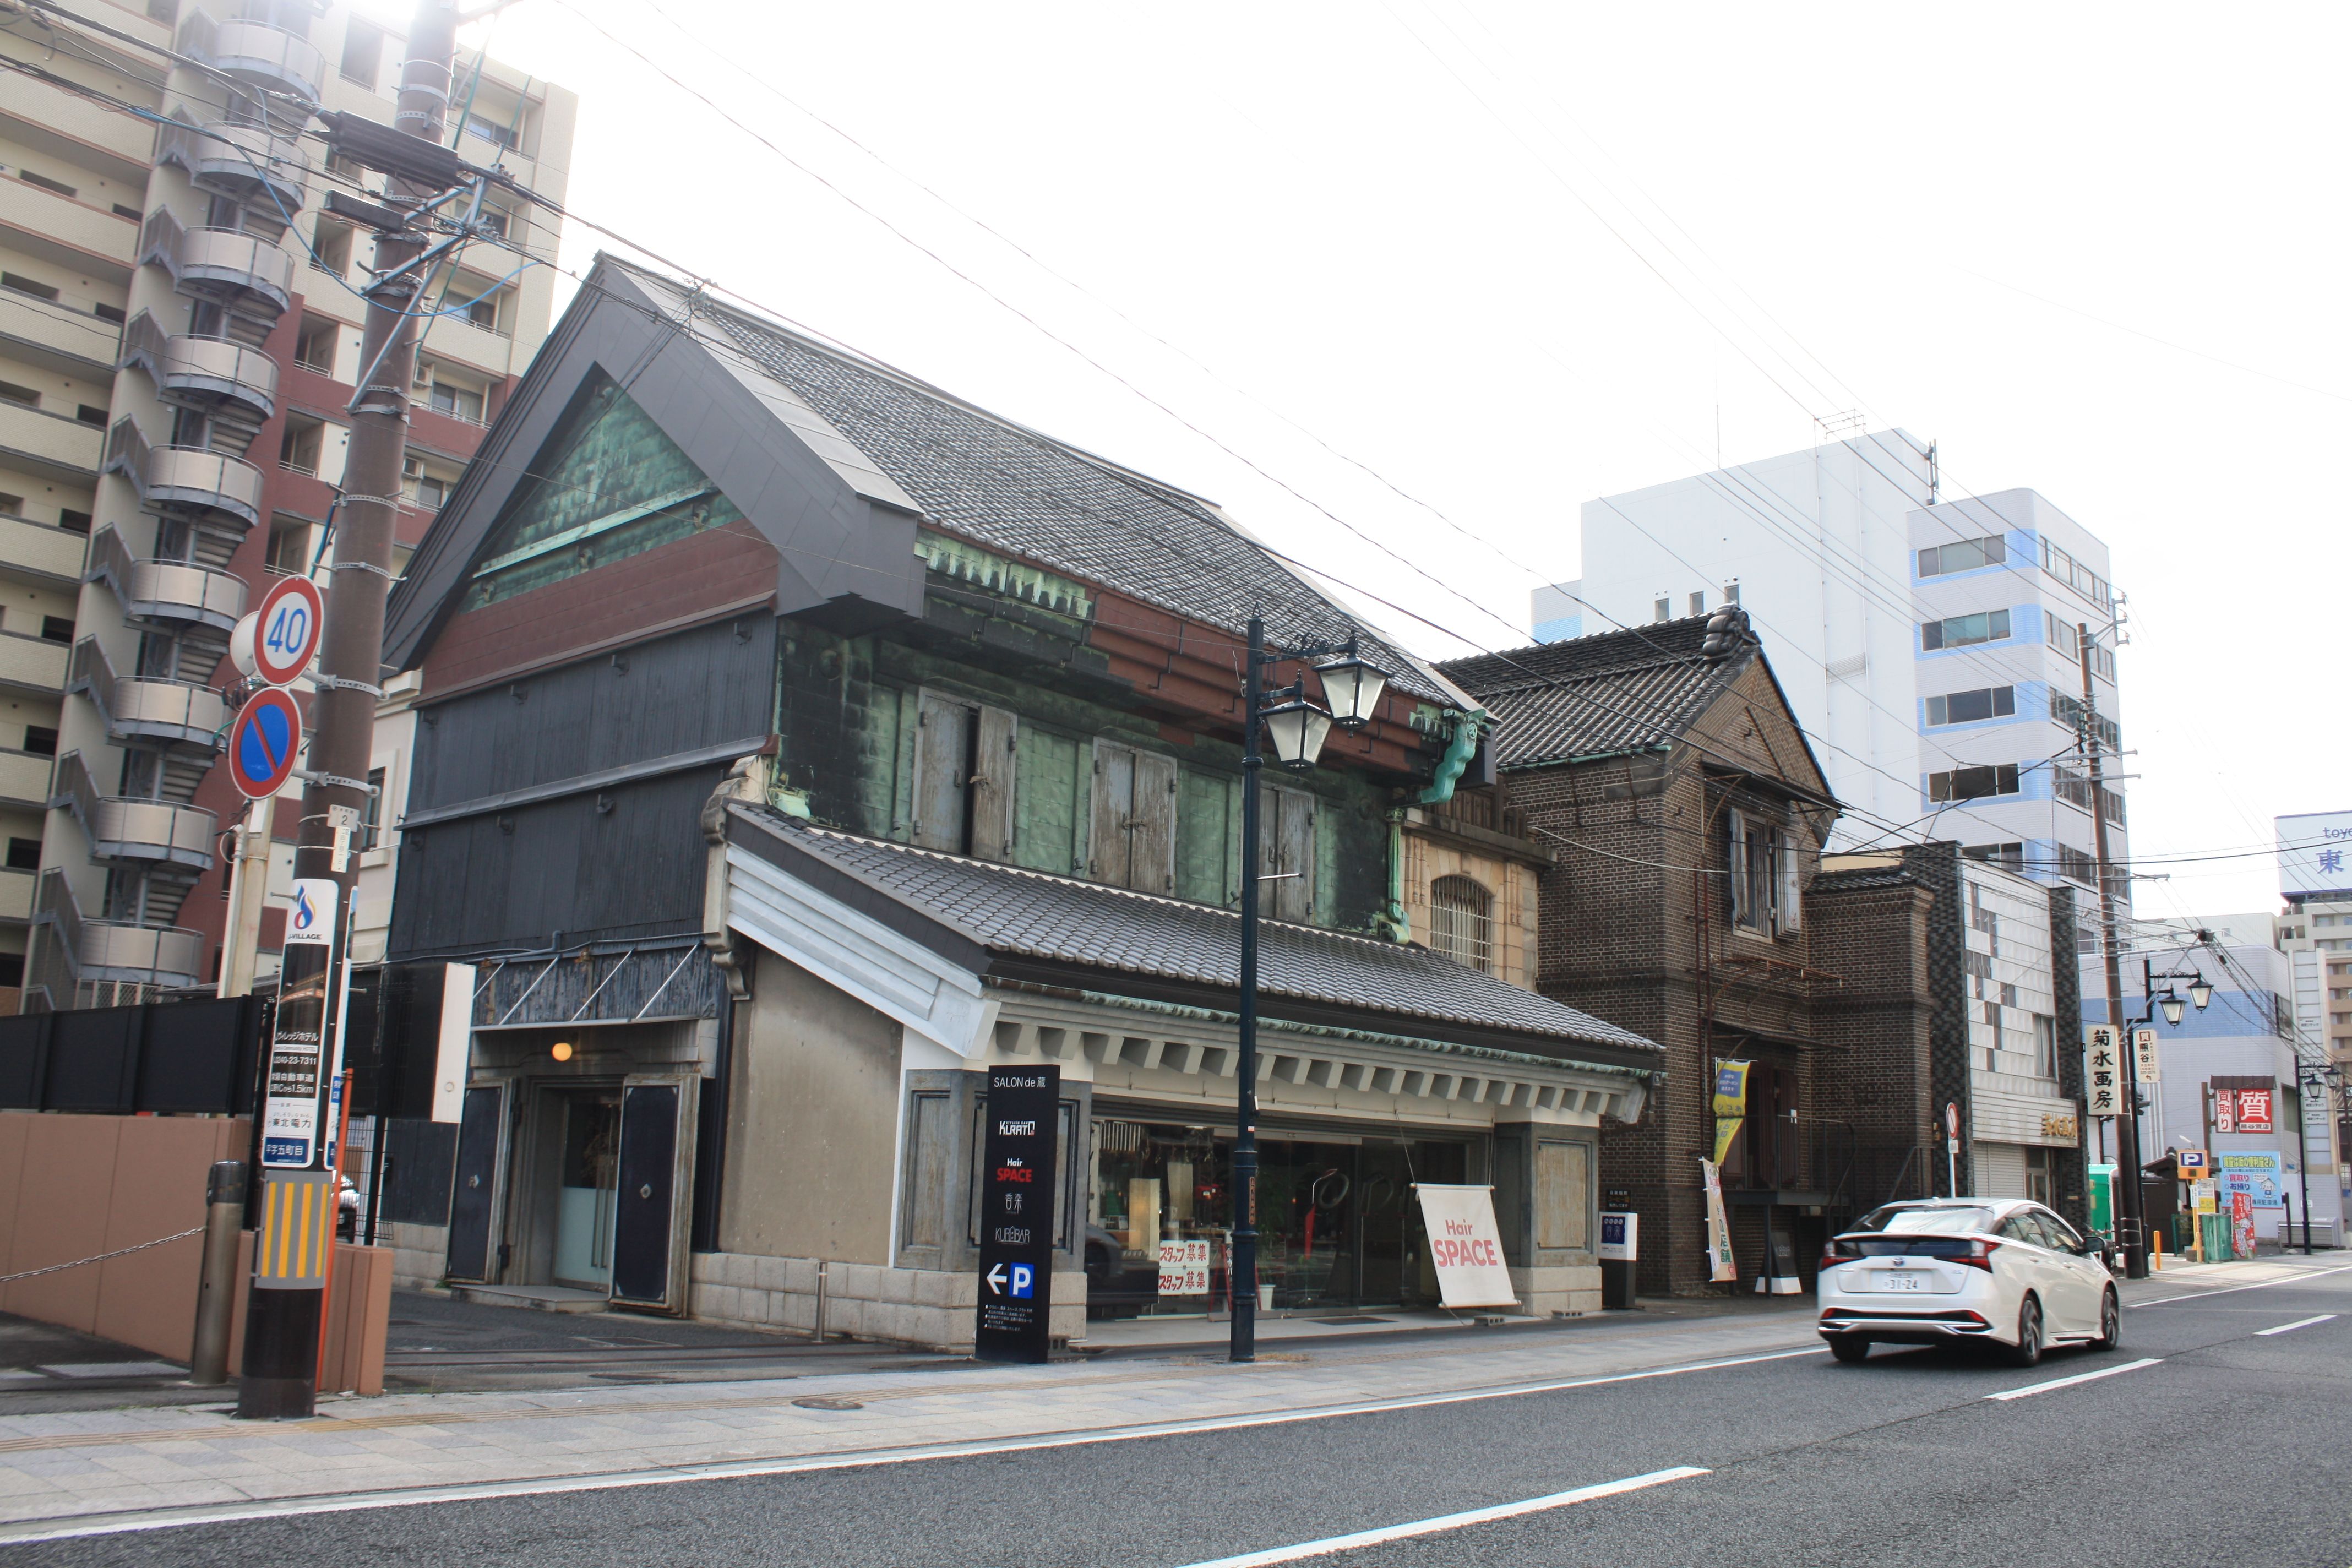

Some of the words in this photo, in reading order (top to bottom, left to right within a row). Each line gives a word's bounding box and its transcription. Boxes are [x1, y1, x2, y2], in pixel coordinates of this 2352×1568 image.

[267, 607, 306, 654] 40
[341, 815, 348, 825] 2
[2316, 849, 2344, 874] 東
[2090, 1028, 2114, 1110] 菊水画房
[994, 1077, 1023, 1087] SALON
[1025, 1077, 1035, 1087] de
[1037, 1077, 1046, 1088] 蔵
[2218, 1090, 2231, 1130] 買取り
[2239, 1091, 2269, 1121] 質
[273, 1118, 311, 1128] 東北電力
[1007, 1158, 1023, 1167] Hair
[2184, 1153, 2199, 1166] P
[997, 1168, 1032, 1182] SPACE
[1445, 1218, 1473, 1235] Hair
[1159, 1243, 1207, 1263] スタッフ募集
[1434, 1239, 1498, 1267] SPACE
[1013, 1267, 1031, 1295] P
[1158, 1271, 1206, 1291] スタッフ募集
[1890, 1280, 1918, 1289] 31-24
